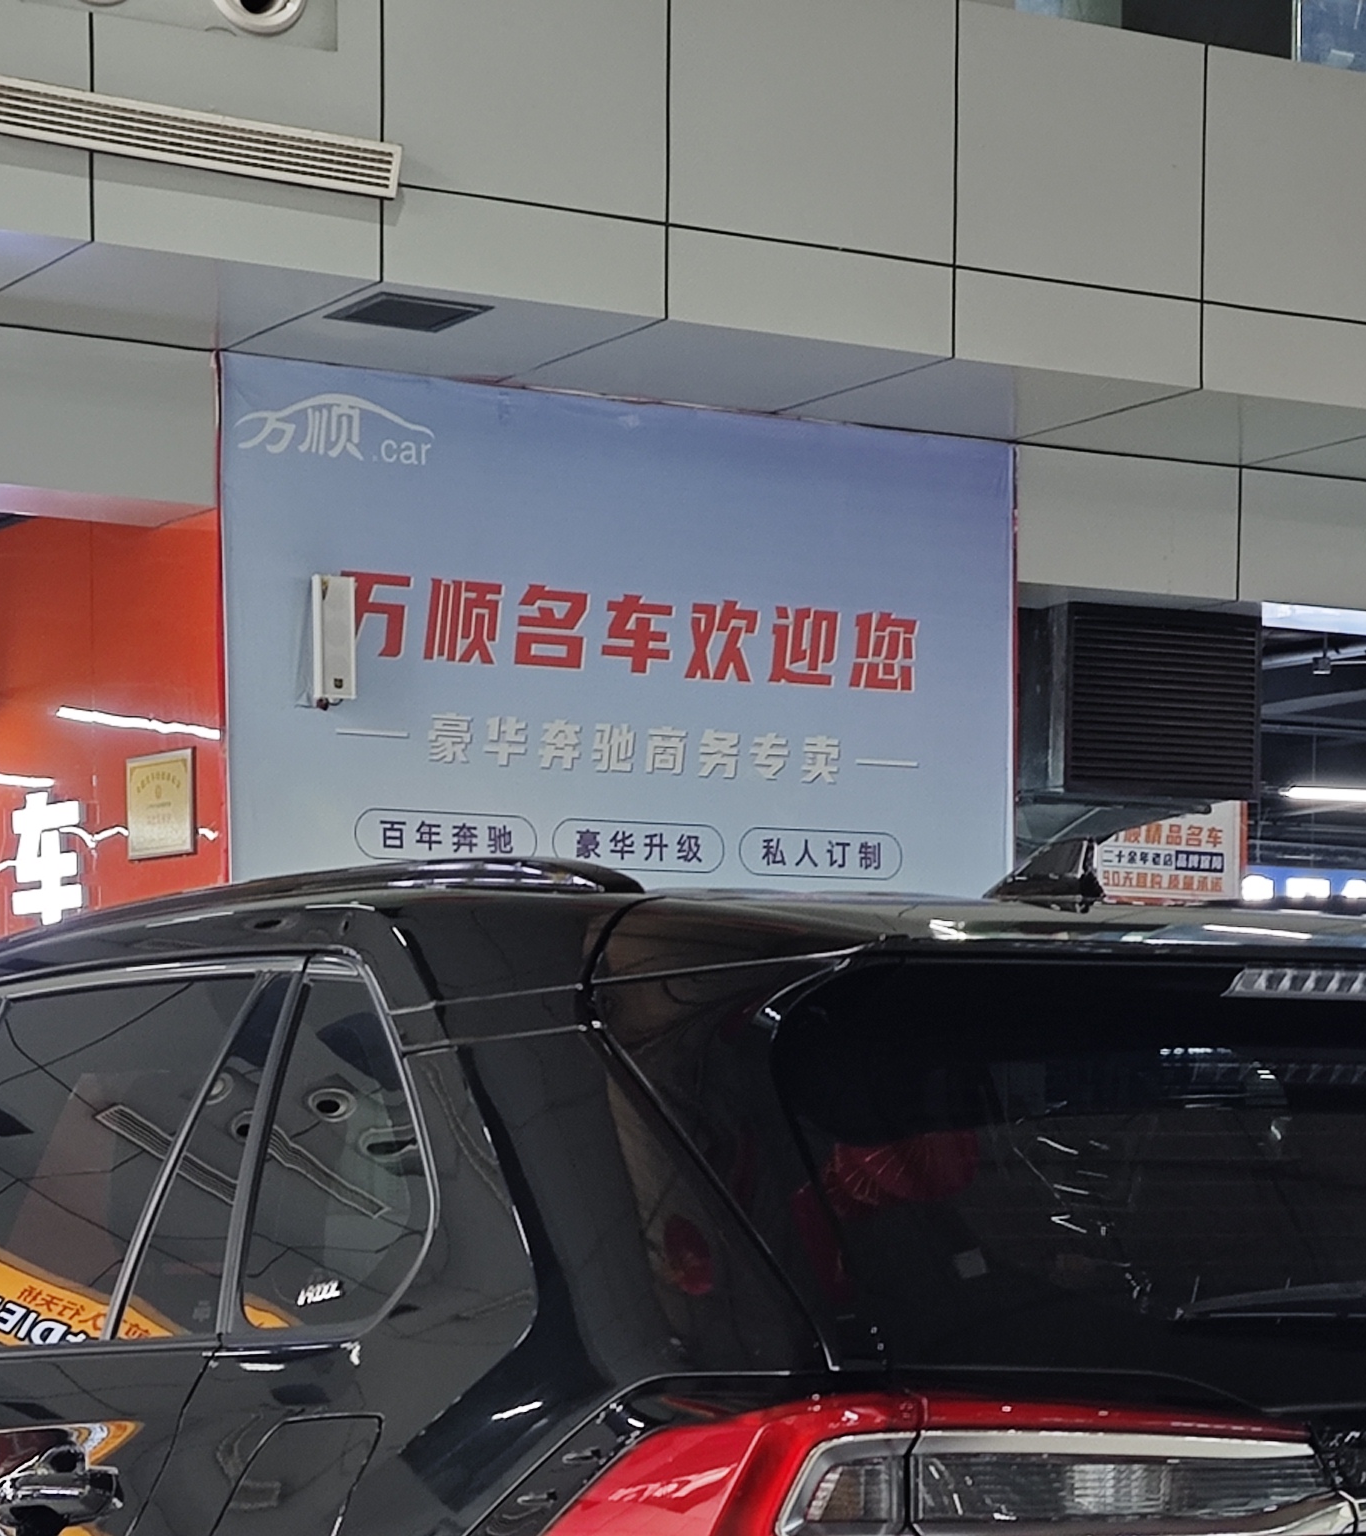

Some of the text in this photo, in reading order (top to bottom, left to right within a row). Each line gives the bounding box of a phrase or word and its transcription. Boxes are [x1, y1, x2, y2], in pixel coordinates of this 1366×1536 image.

[341, 570, 919, 693] 万顺名车欢迎您
[427, 712, 842, 785] 豪华奔驰商务专卖
[379, 819, 515, 855] 百年奔驰
[573, 826, 704, 865] 豪华升级
[761, 837, 882, 871] 私人订制
